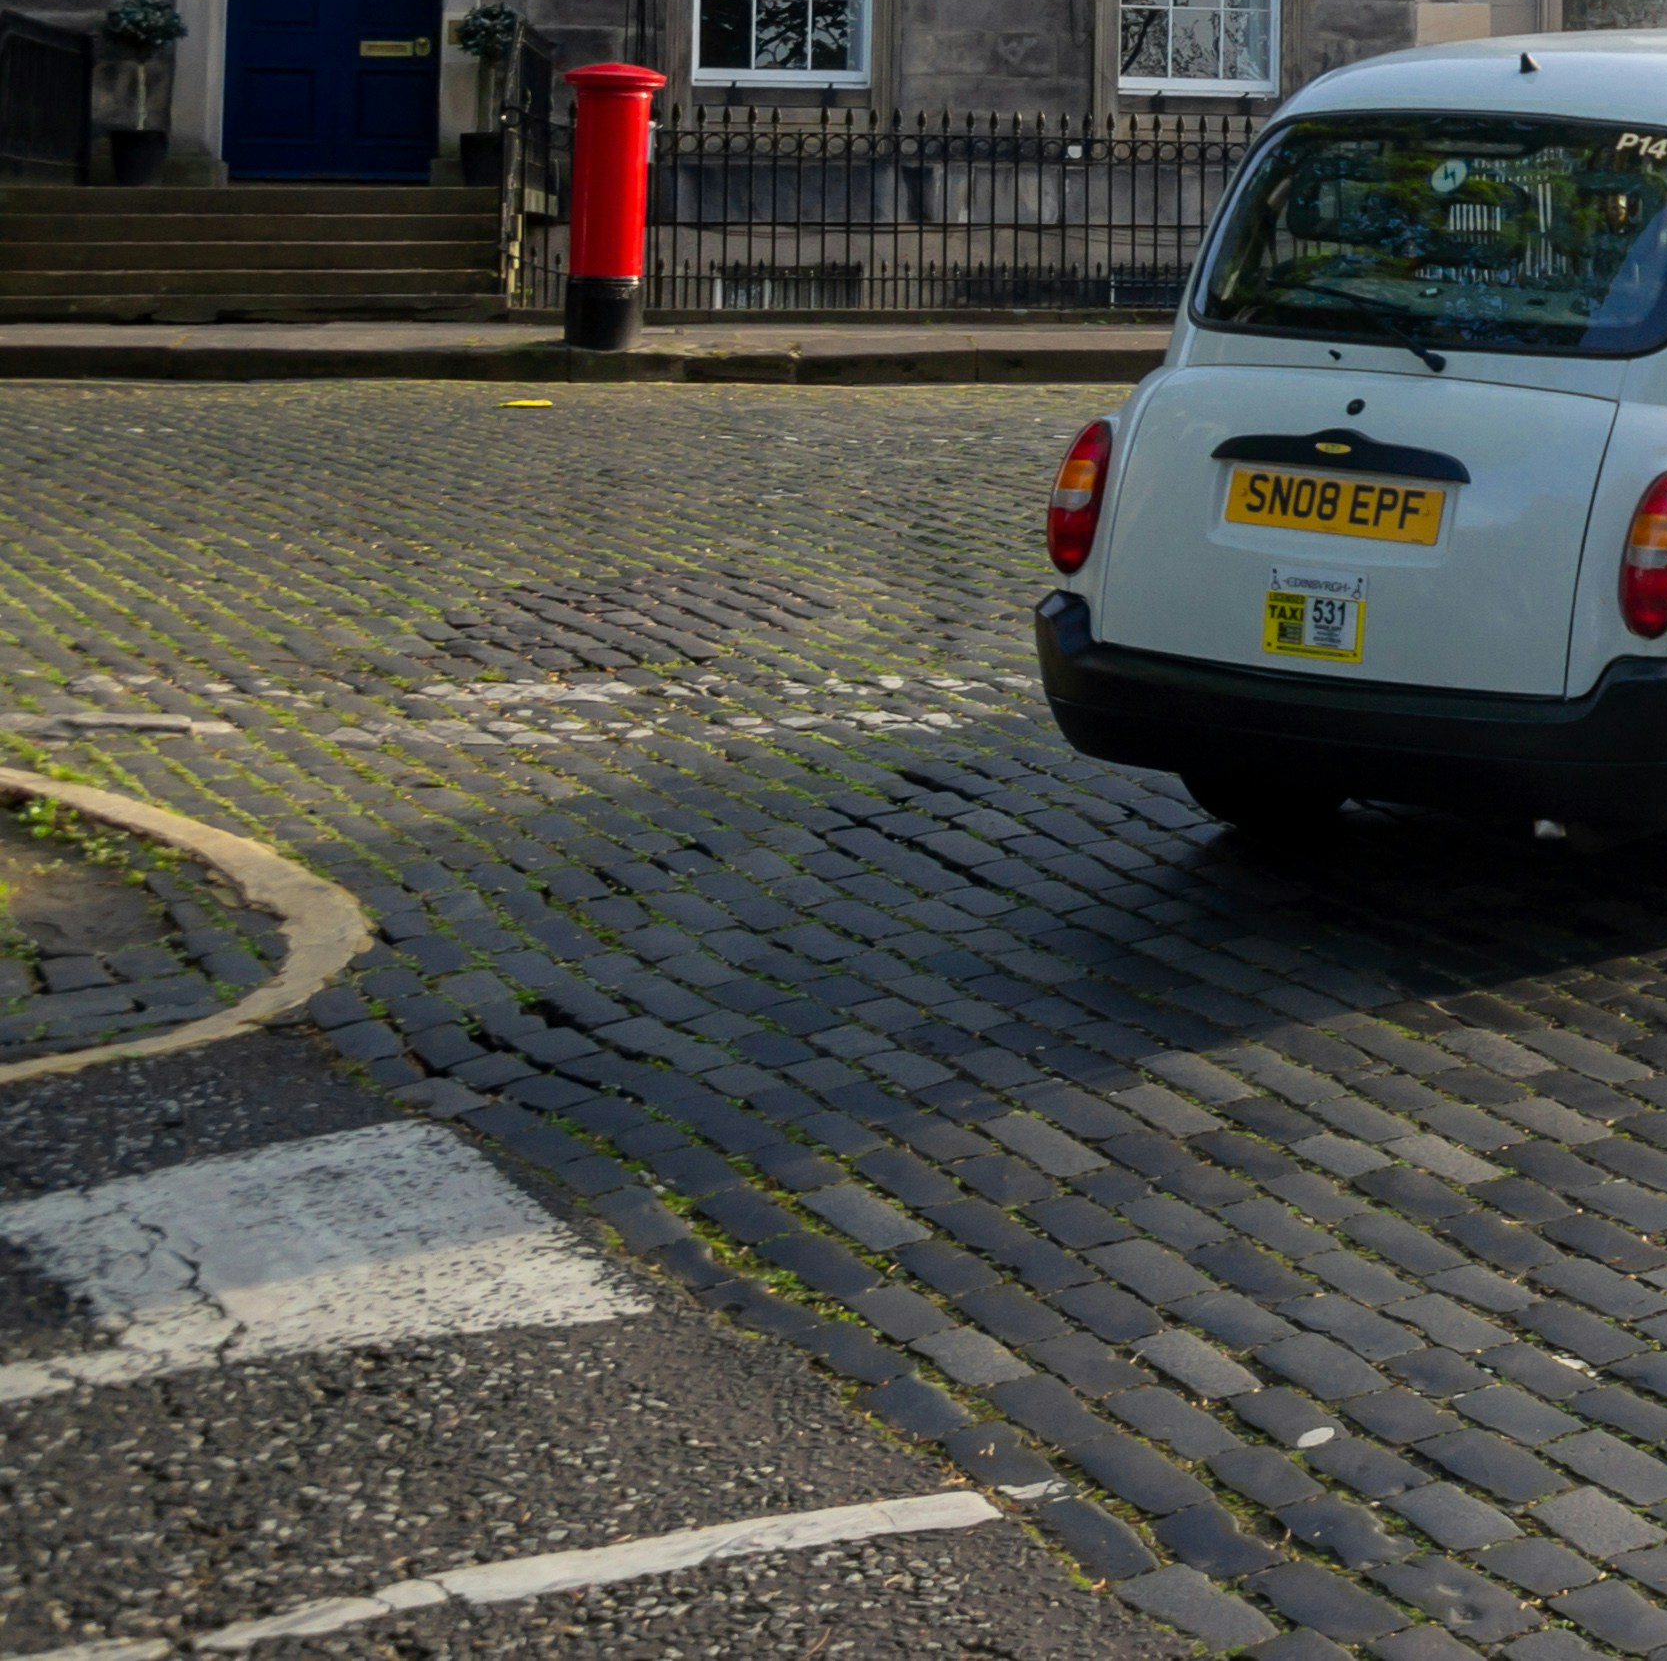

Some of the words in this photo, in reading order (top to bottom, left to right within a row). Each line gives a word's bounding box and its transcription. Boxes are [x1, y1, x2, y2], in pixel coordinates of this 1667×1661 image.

[1246, 473, 1341, 521] SN08
[1348, 484, 1426, 529] EPF
[1269, 605, 1304, 621] TAXI
[1312, 598, 1346, 626] 531
